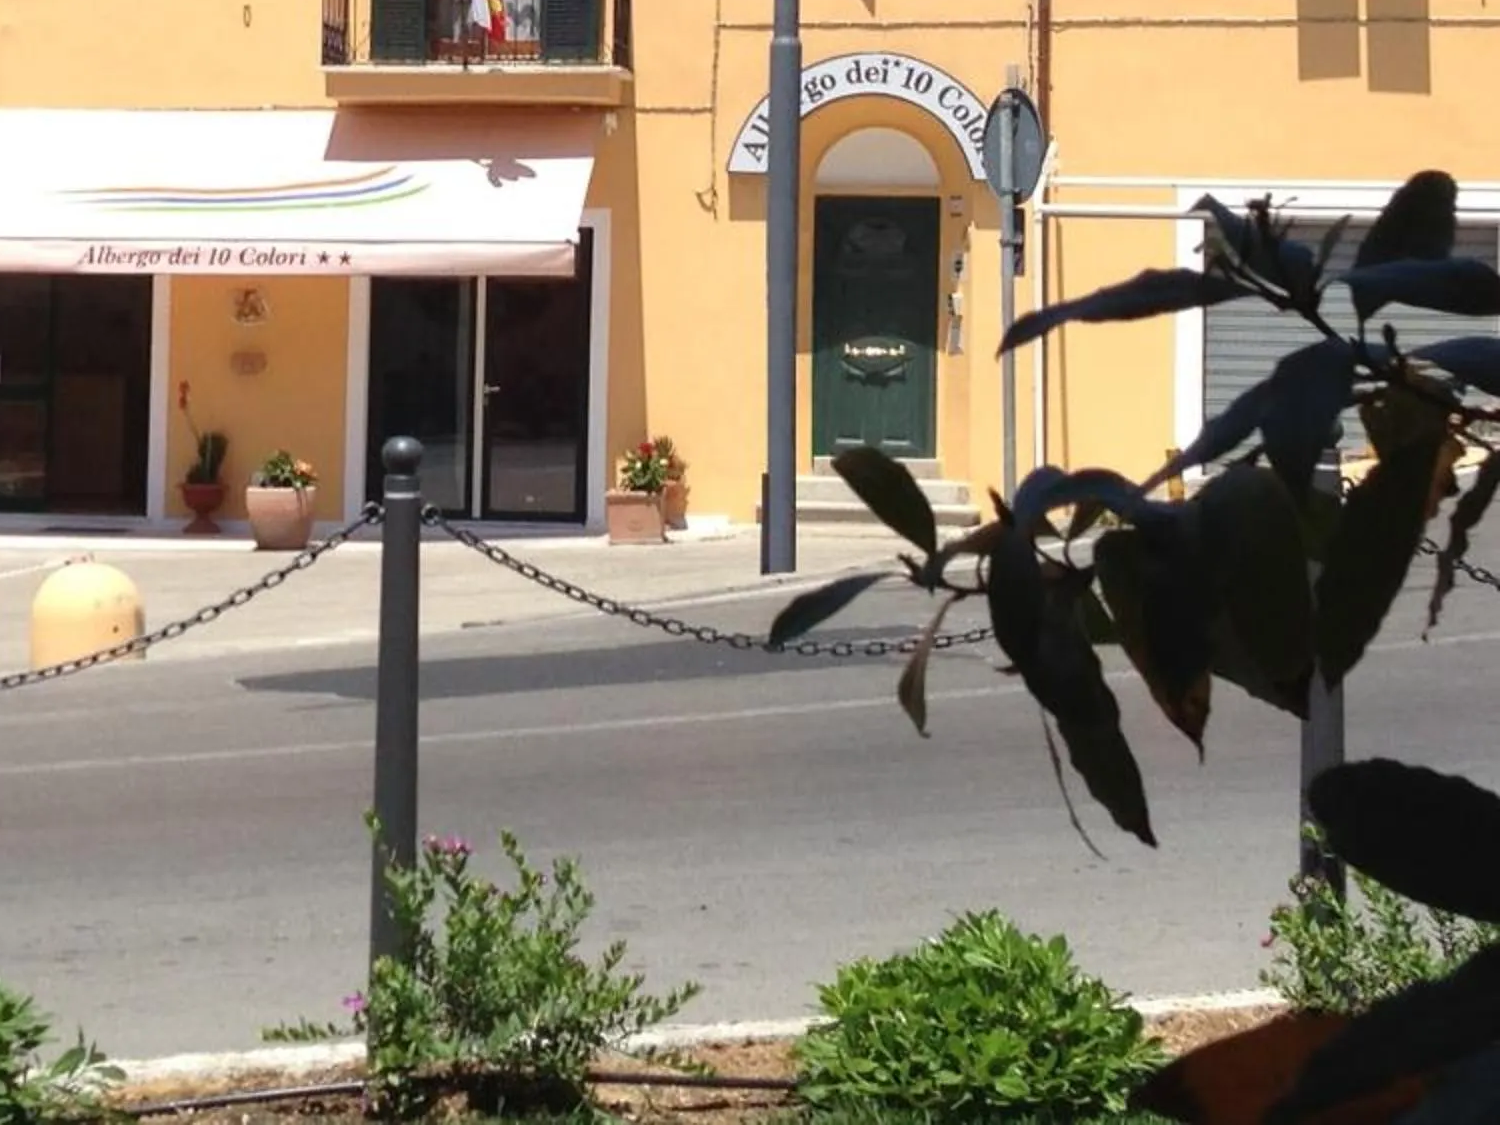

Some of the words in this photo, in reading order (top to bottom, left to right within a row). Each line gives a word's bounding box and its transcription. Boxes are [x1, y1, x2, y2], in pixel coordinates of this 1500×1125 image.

[743, 72, 836, 163] Algo
[846, 59, 889, 84] dei
[901, 66, 933, 94] 10
[938, 85, 985, 155] Colo
[79, 244, 161, 268] Albergo
[168, 246, 200, 265] dei
[208, 247, 232, 266] 10
[238, 247, 306, 267] Colori
